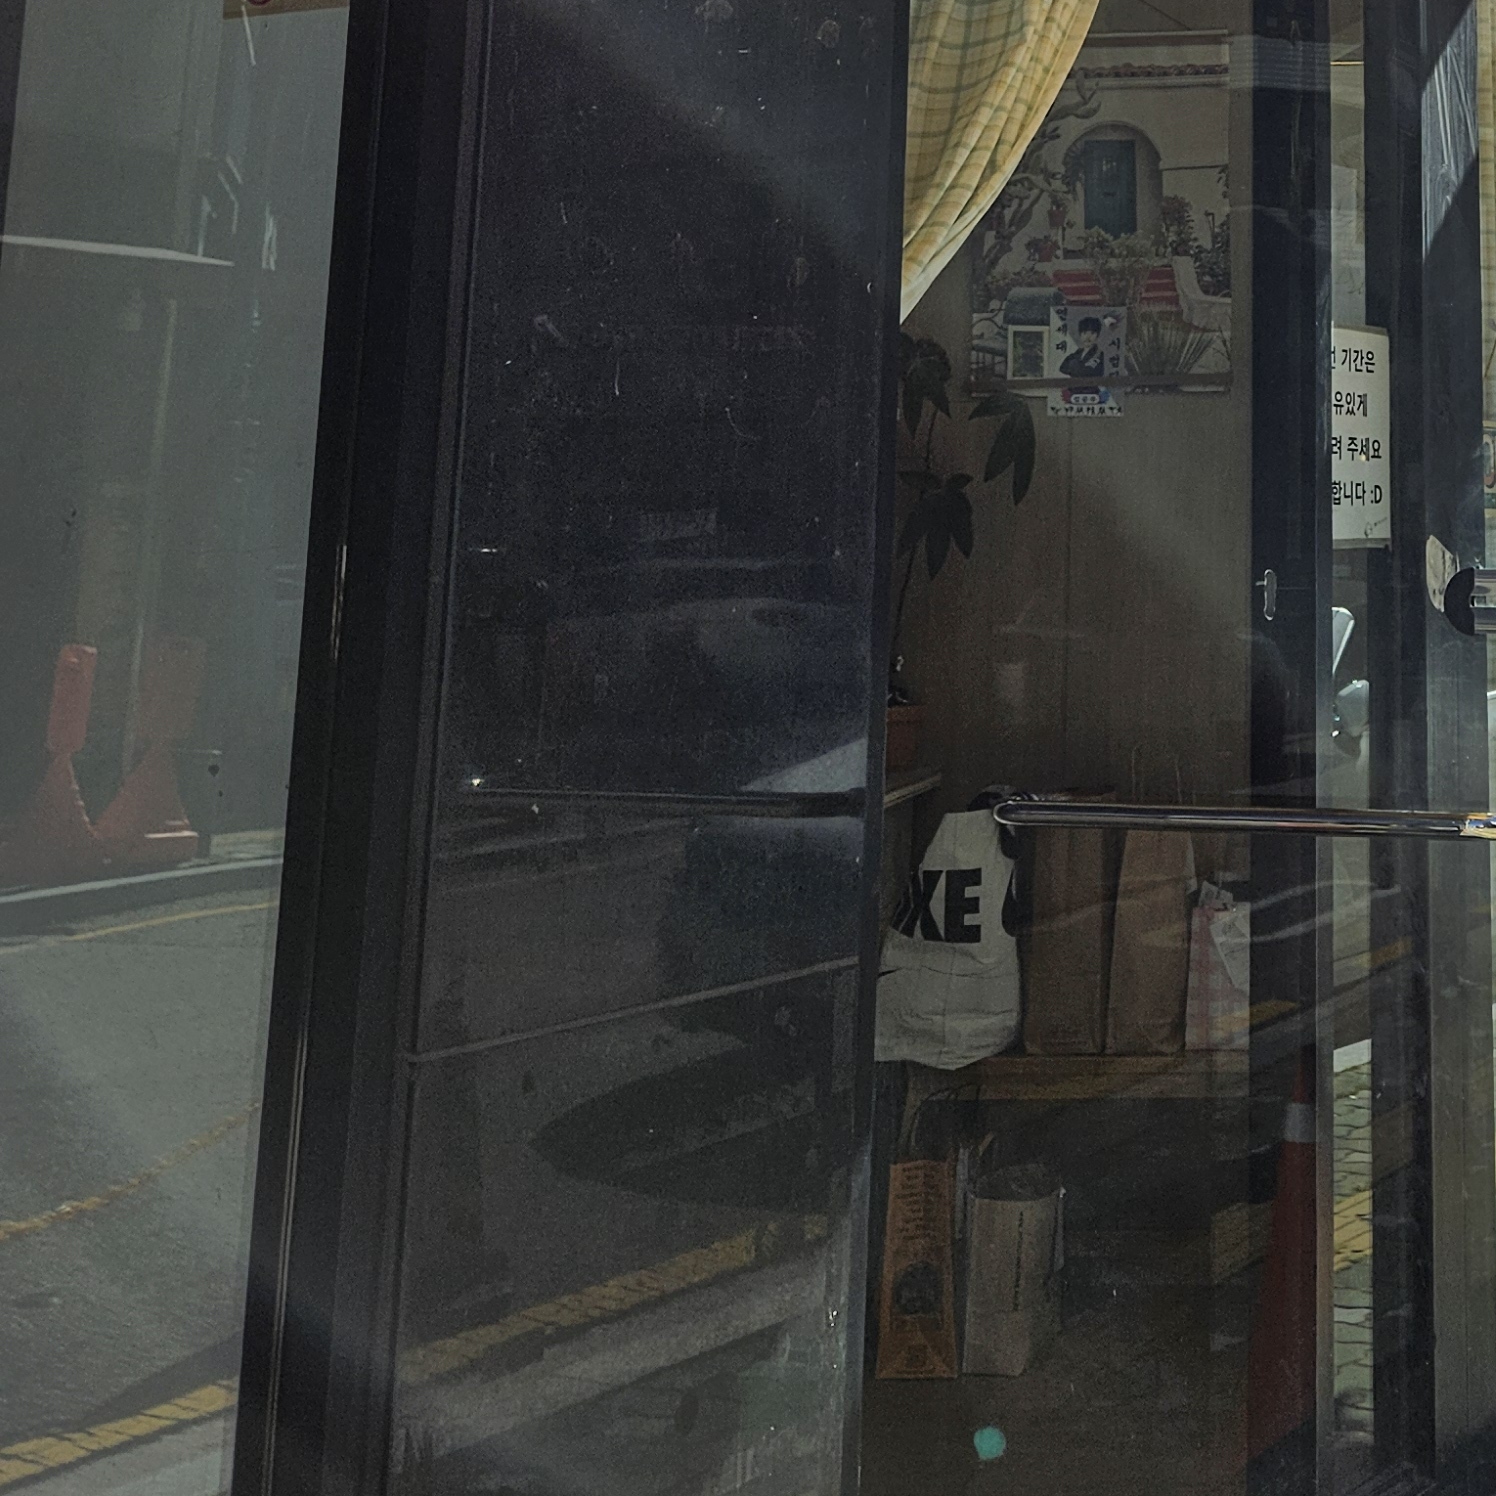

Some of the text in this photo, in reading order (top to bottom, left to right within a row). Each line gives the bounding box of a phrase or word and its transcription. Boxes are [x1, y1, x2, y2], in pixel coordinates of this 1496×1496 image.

[1341, 348, 1375, 373] 기간은
[1333, 391, 1368, 417] 유있게
[1347, 437, 1381, 462] 주세요
[1331, 481, 1383, 506] 합니다 :D
